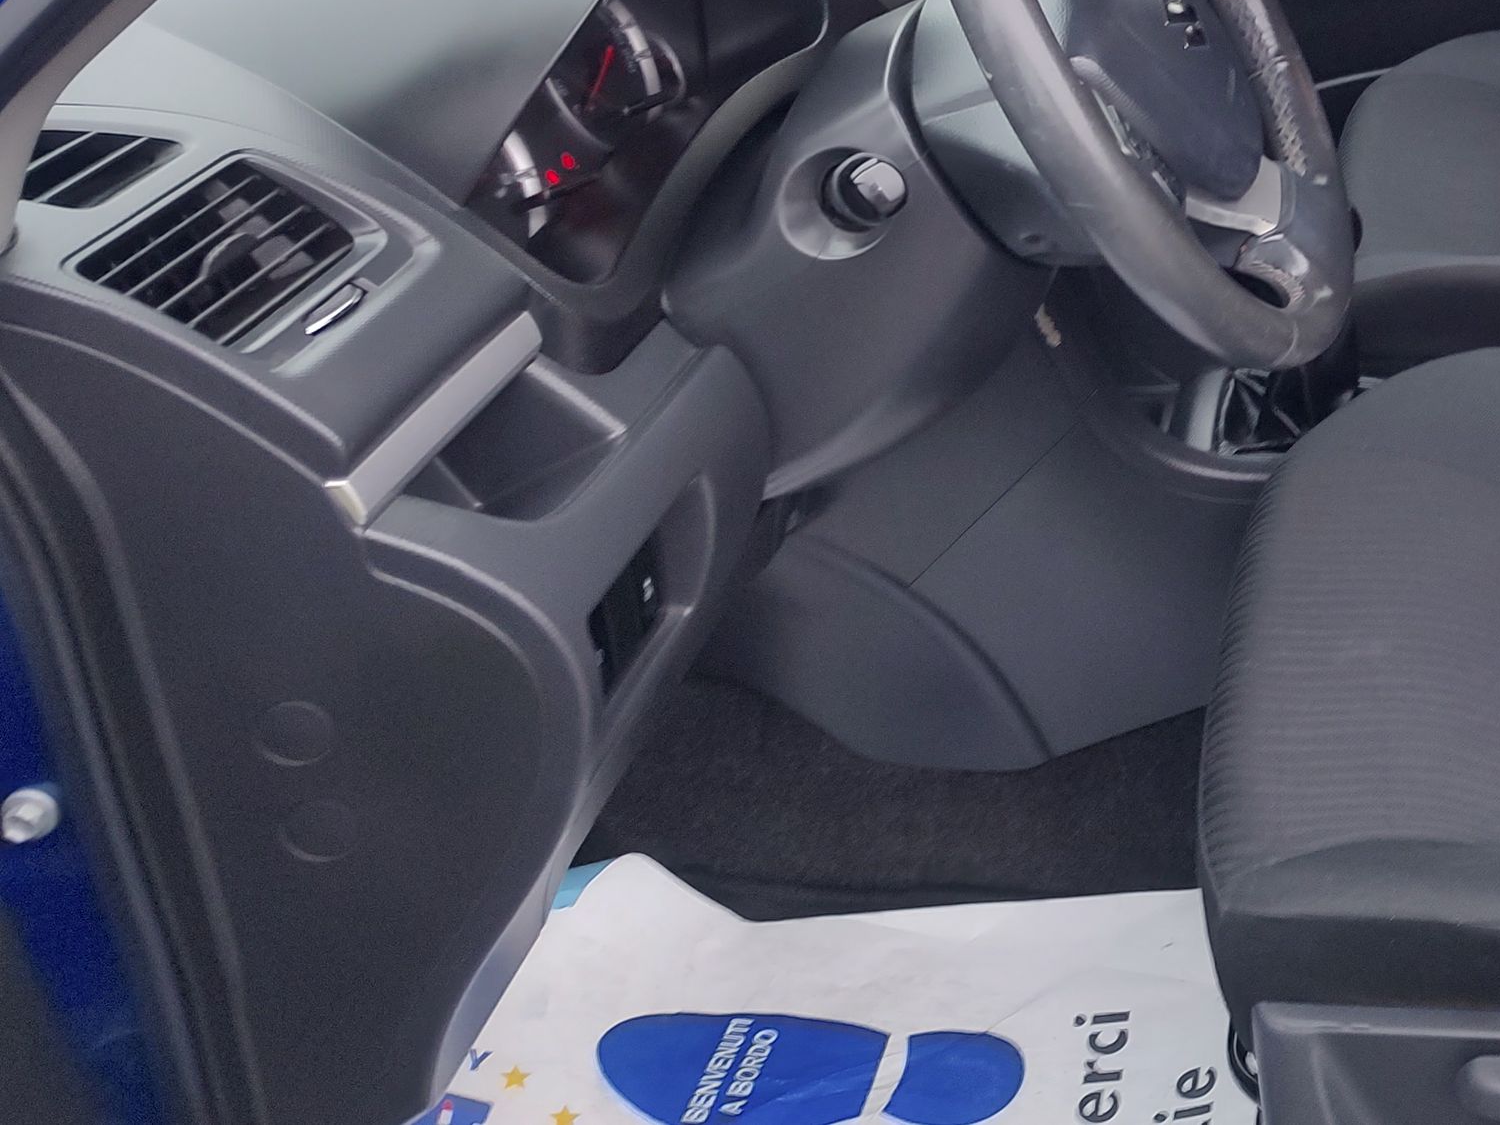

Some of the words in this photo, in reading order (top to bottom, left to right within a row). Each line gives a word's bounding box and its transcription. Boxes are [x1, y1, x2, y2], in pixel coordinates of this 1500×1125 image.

[680, 1017, 755, 1124] BENVENUTI
[725, 1028, 780, 1097] BORDO
[718, 1099, 749, 1116] A
[1153, 1066, 1217, 1125] ie
